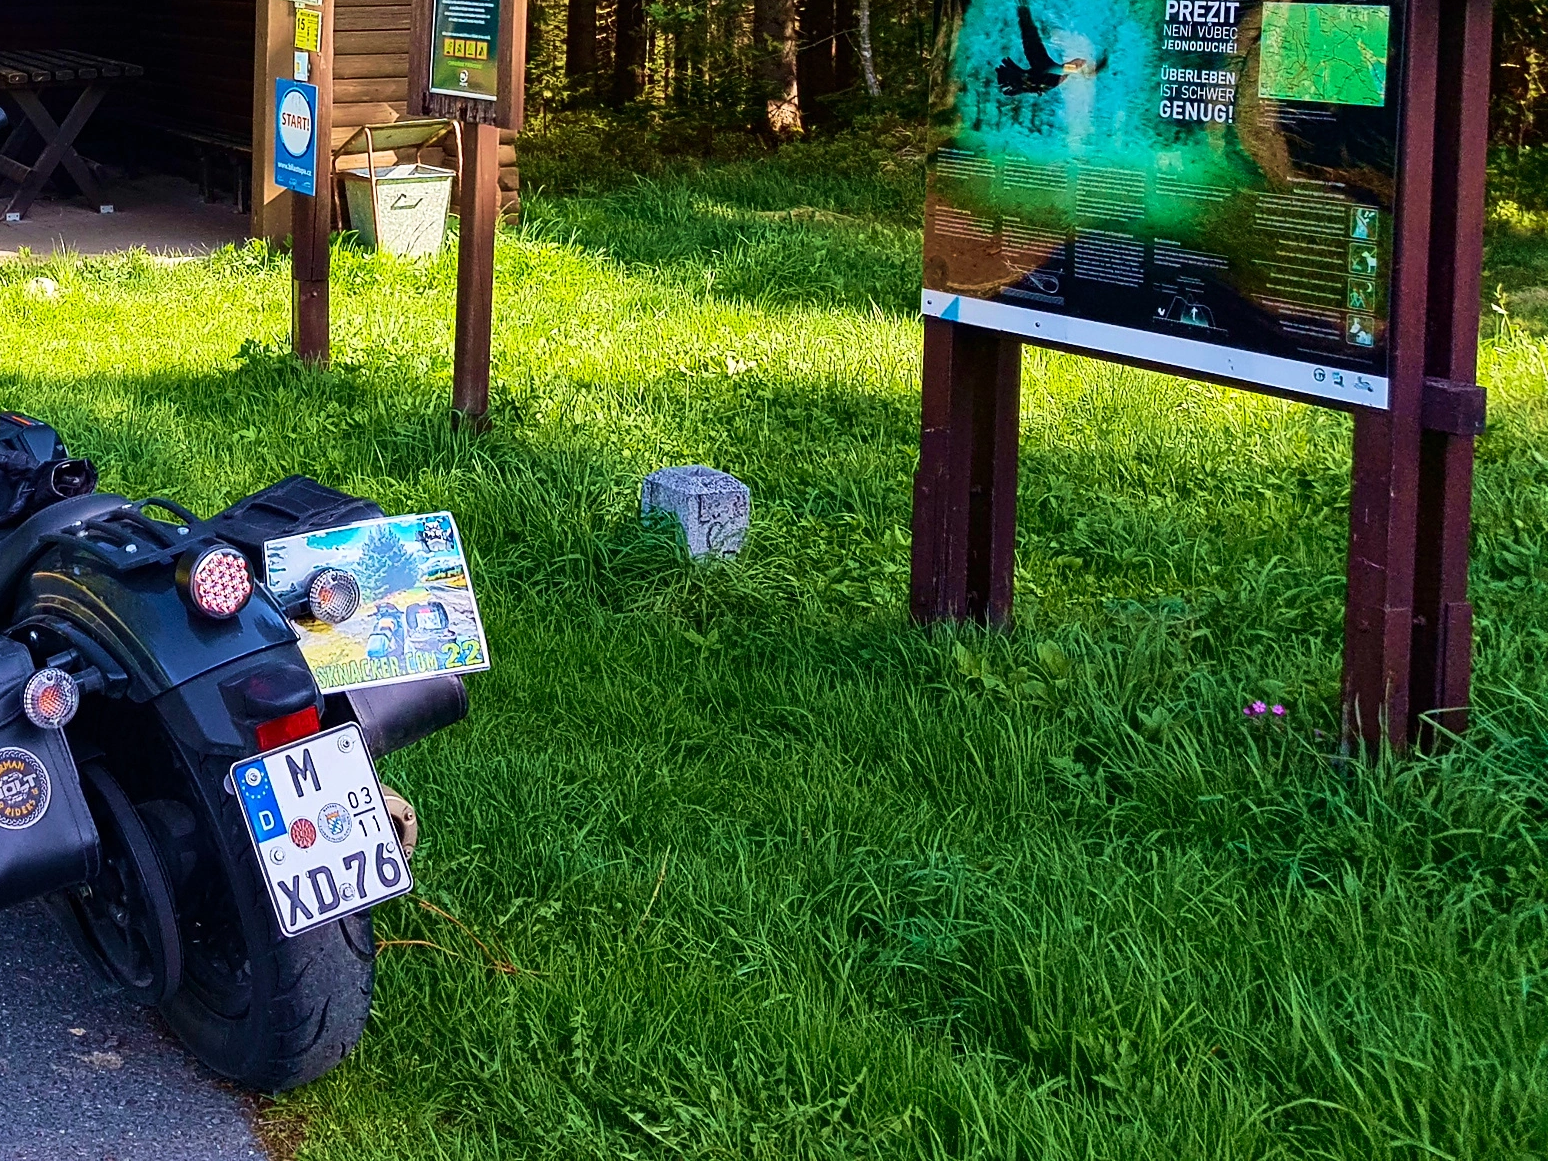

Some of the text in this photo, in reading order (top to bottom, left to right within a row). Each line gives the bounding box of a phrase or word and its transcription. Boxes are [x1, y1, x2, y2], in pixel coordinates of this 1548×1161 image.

[297, 18, 306, 31] 15
[1163, 22, 1239, 39] NENÍ VŮBEC
[1161, 39, 1237, 54] JEDNODUCHÉ!
[1160, 65, 1236, 85] ÜBERLEBEN
[1160, 83, 1235, 102] IST SCHWER
[1159, 100, 1234, 123] GENUG!
[281, 112, 310, 132] START!
[441, 639, 483, 668] 22
[285, 748, 322, 798] M
[347, 786, 373, 809] 03
[4, 799, 37, 817] RIDERS
[258, 809, 275, 831] D
[358, 814, 381, 837] 11
